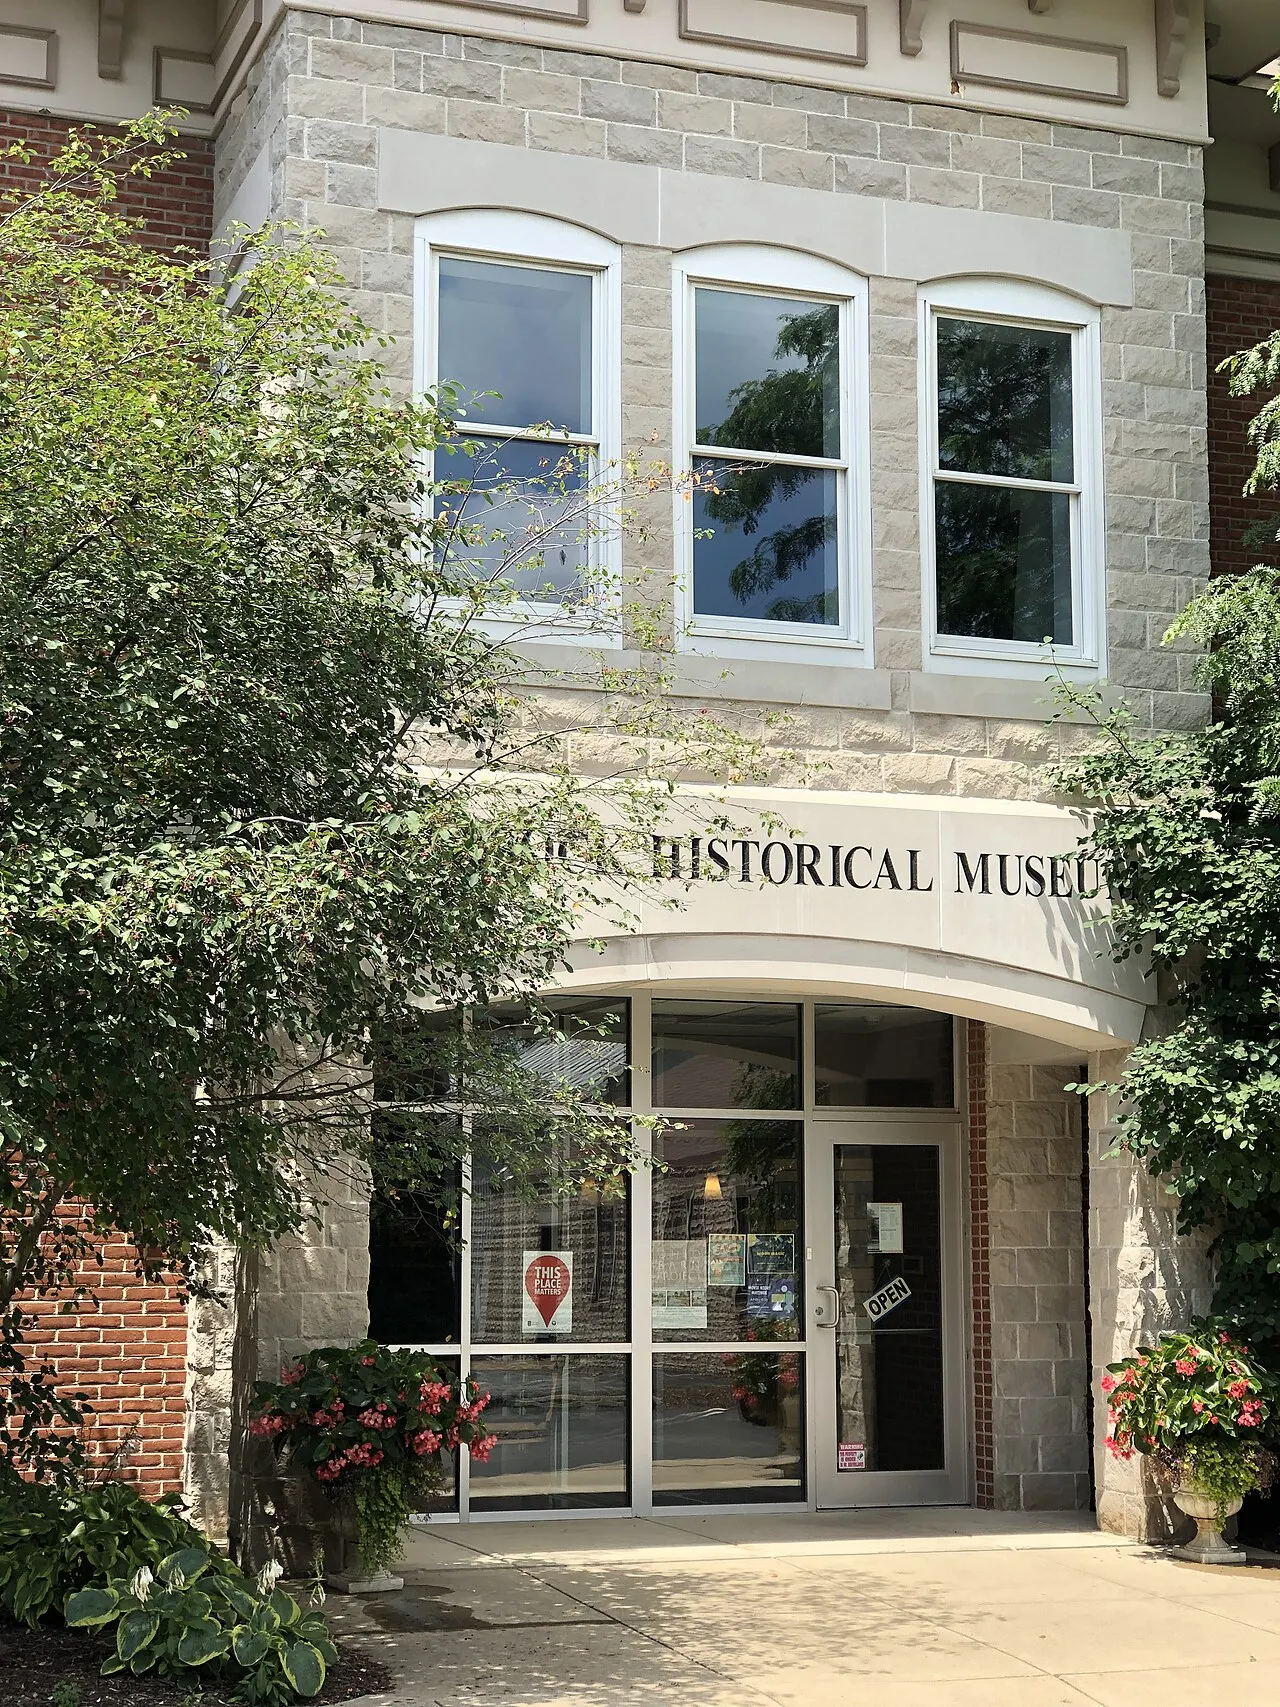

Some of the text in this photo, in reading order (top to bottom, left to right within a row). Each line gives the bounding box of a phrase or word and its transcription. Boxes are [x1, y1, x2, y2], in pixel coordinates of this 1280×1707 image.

[651, 834, 934, 892] HISTORICAL
[534, 1266, 561, 1279] THIS
[534, 1279, 561, 1288] PLACE
[868, 1278, 908, 1316] OPEN
